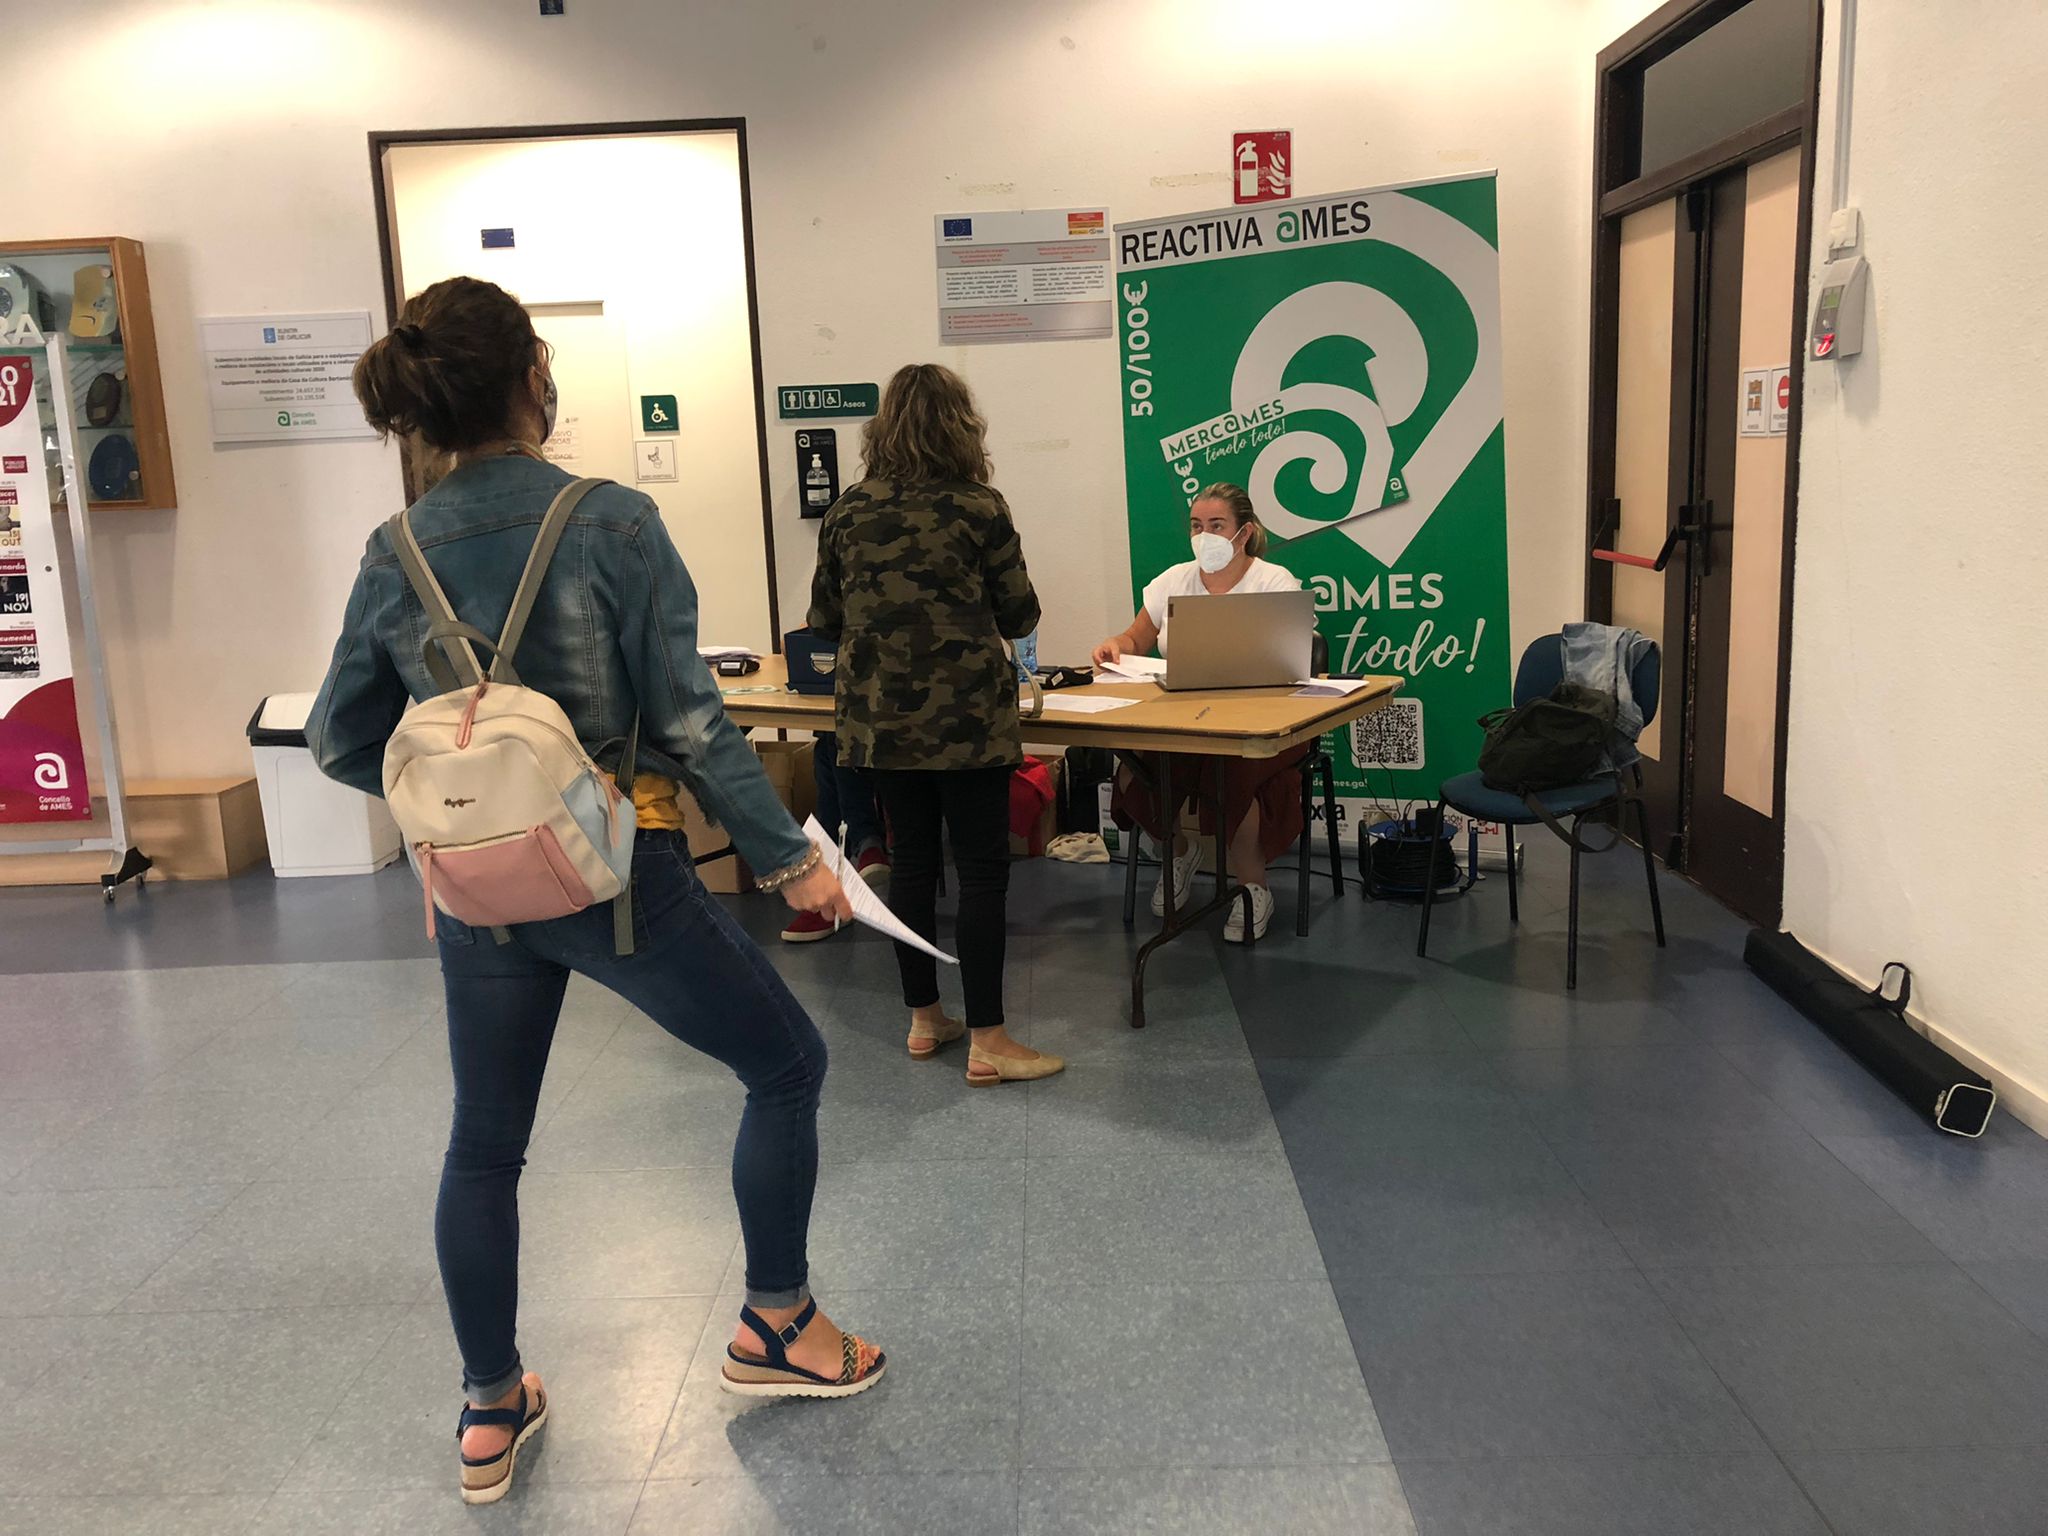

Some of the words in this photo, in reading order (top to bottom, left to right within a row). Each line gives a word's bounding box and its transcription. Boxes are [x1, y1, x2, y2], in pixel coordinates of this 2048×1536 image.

[1121, 216, 1263, 265] REACTIVA
[1123, 280, 1154, 416] 50/100€
[0, 365, 19, 386] 0
[842, 400, 867, 408] Aseos
[3, 601, 30, 612] NOV
[1336, 616, 1486, 677] todo!
[38, 796, 71, 804] Concello
[39, 803, 49, 811] de
[50, 802, 73, 811] AMES
